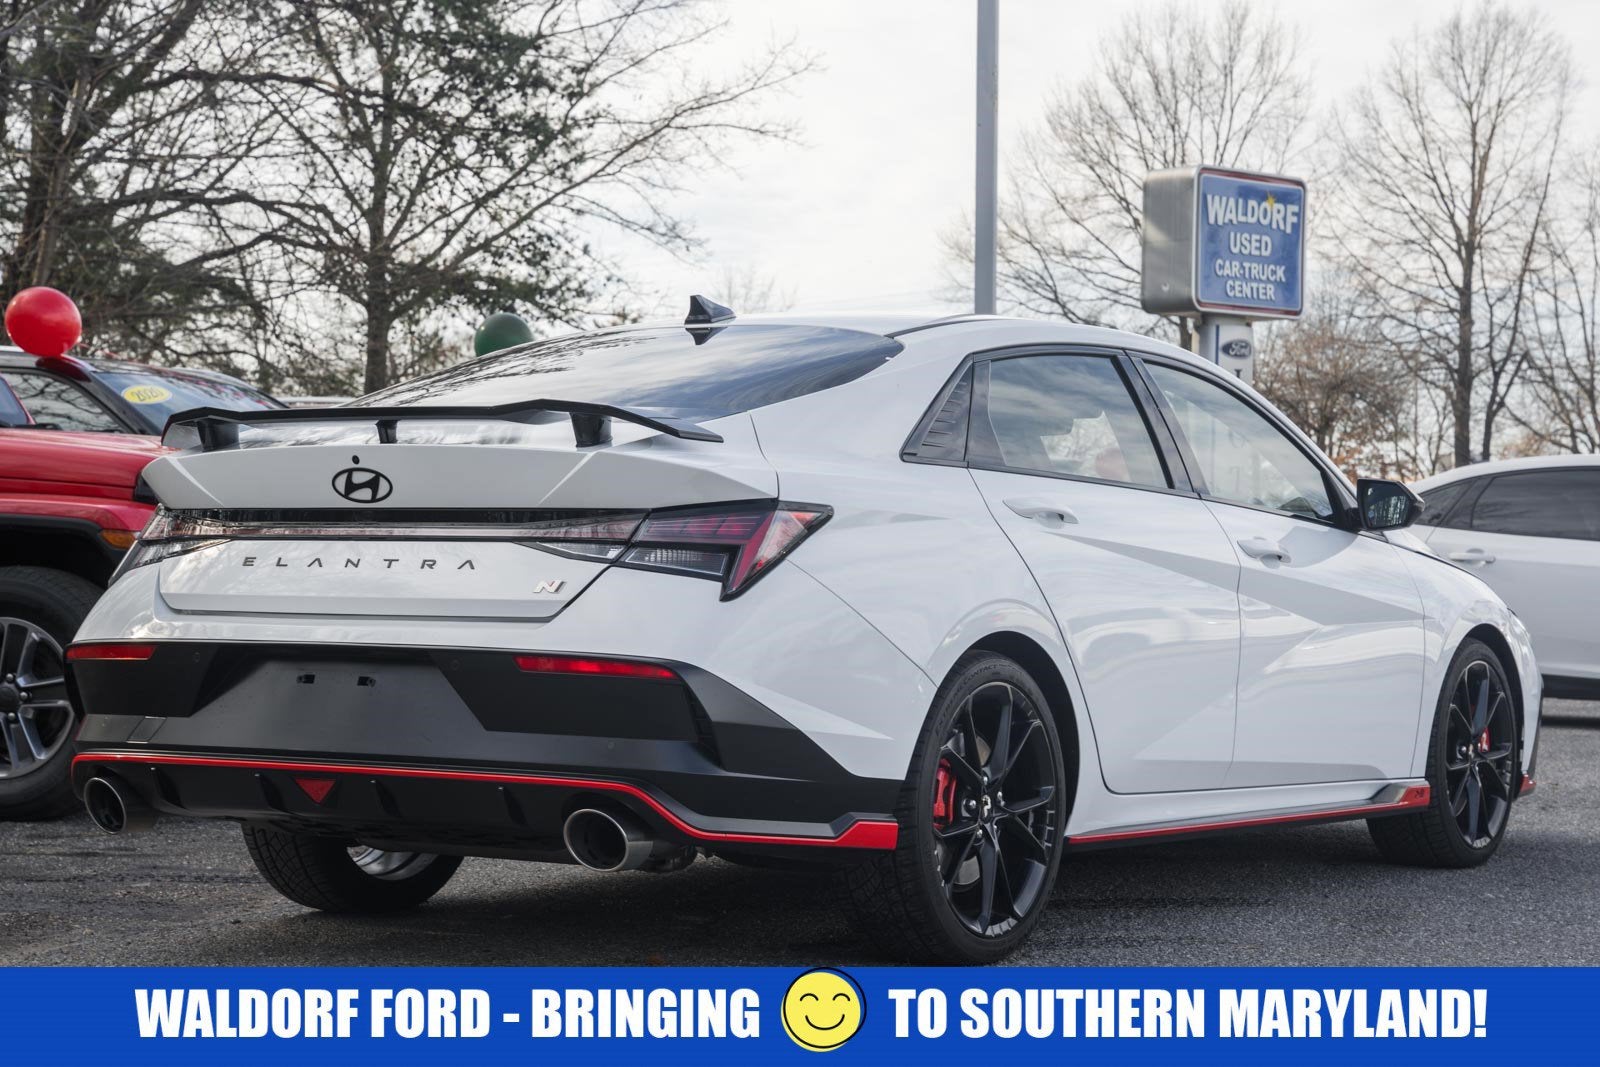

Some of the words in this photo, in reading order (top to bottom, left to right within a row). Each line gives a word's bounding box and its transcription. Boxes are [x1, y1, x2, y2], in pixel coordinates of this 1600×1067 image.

[1206, 194, 1299, 234] WALDORF
[1229, 231, 1272, 256] USED
[1226, 280, 1275, 300] CENTER
[1227, 341, 1250, 357] Ford
[242, 556, 475, 570] ELANTRA
